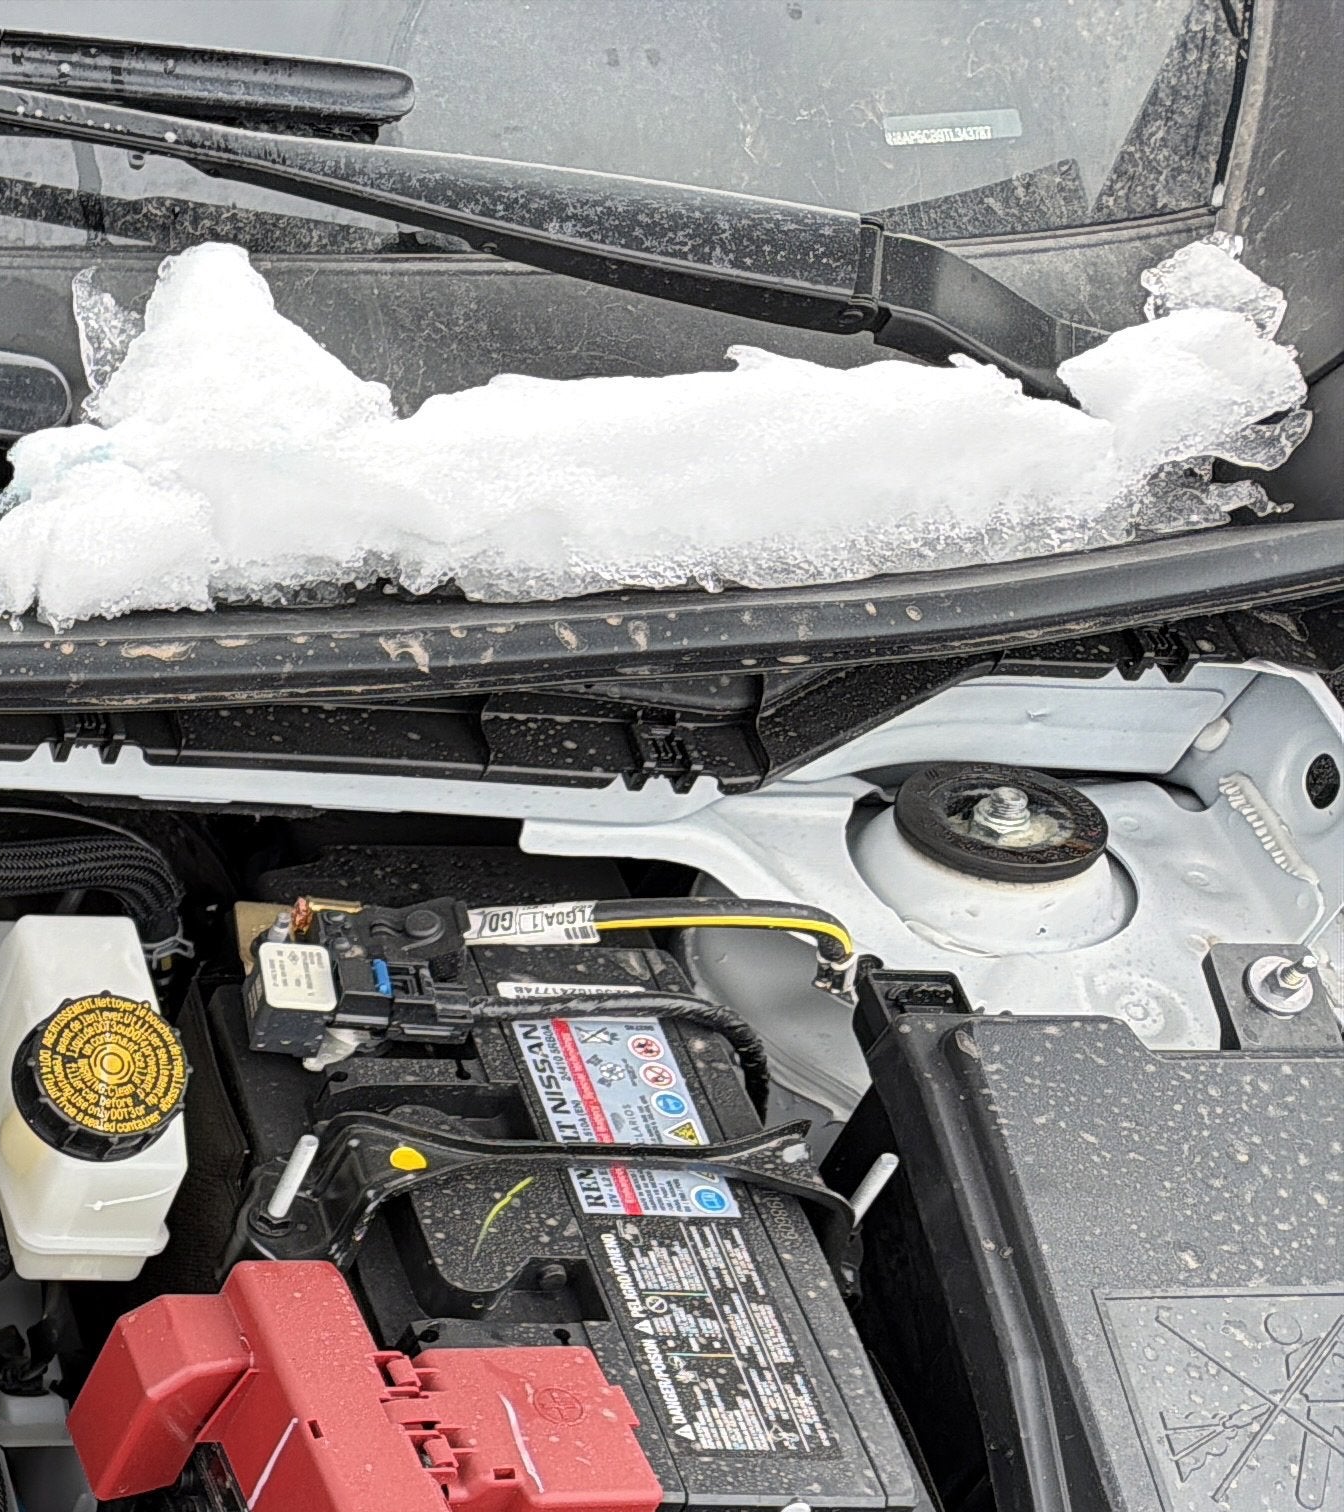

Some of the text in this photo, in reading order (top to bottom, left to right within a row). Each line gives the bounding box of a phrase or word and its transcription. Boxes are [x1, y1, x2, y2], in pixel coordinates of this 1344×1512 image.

[144, 1010, 177, 1045] bouchon
[518, 1023, 571, 1114] NISSAN
[600, 1233, 641, 1318] PELIGRO/VENENO
[642, 1339, 683, 1425] DANGER/POISON
